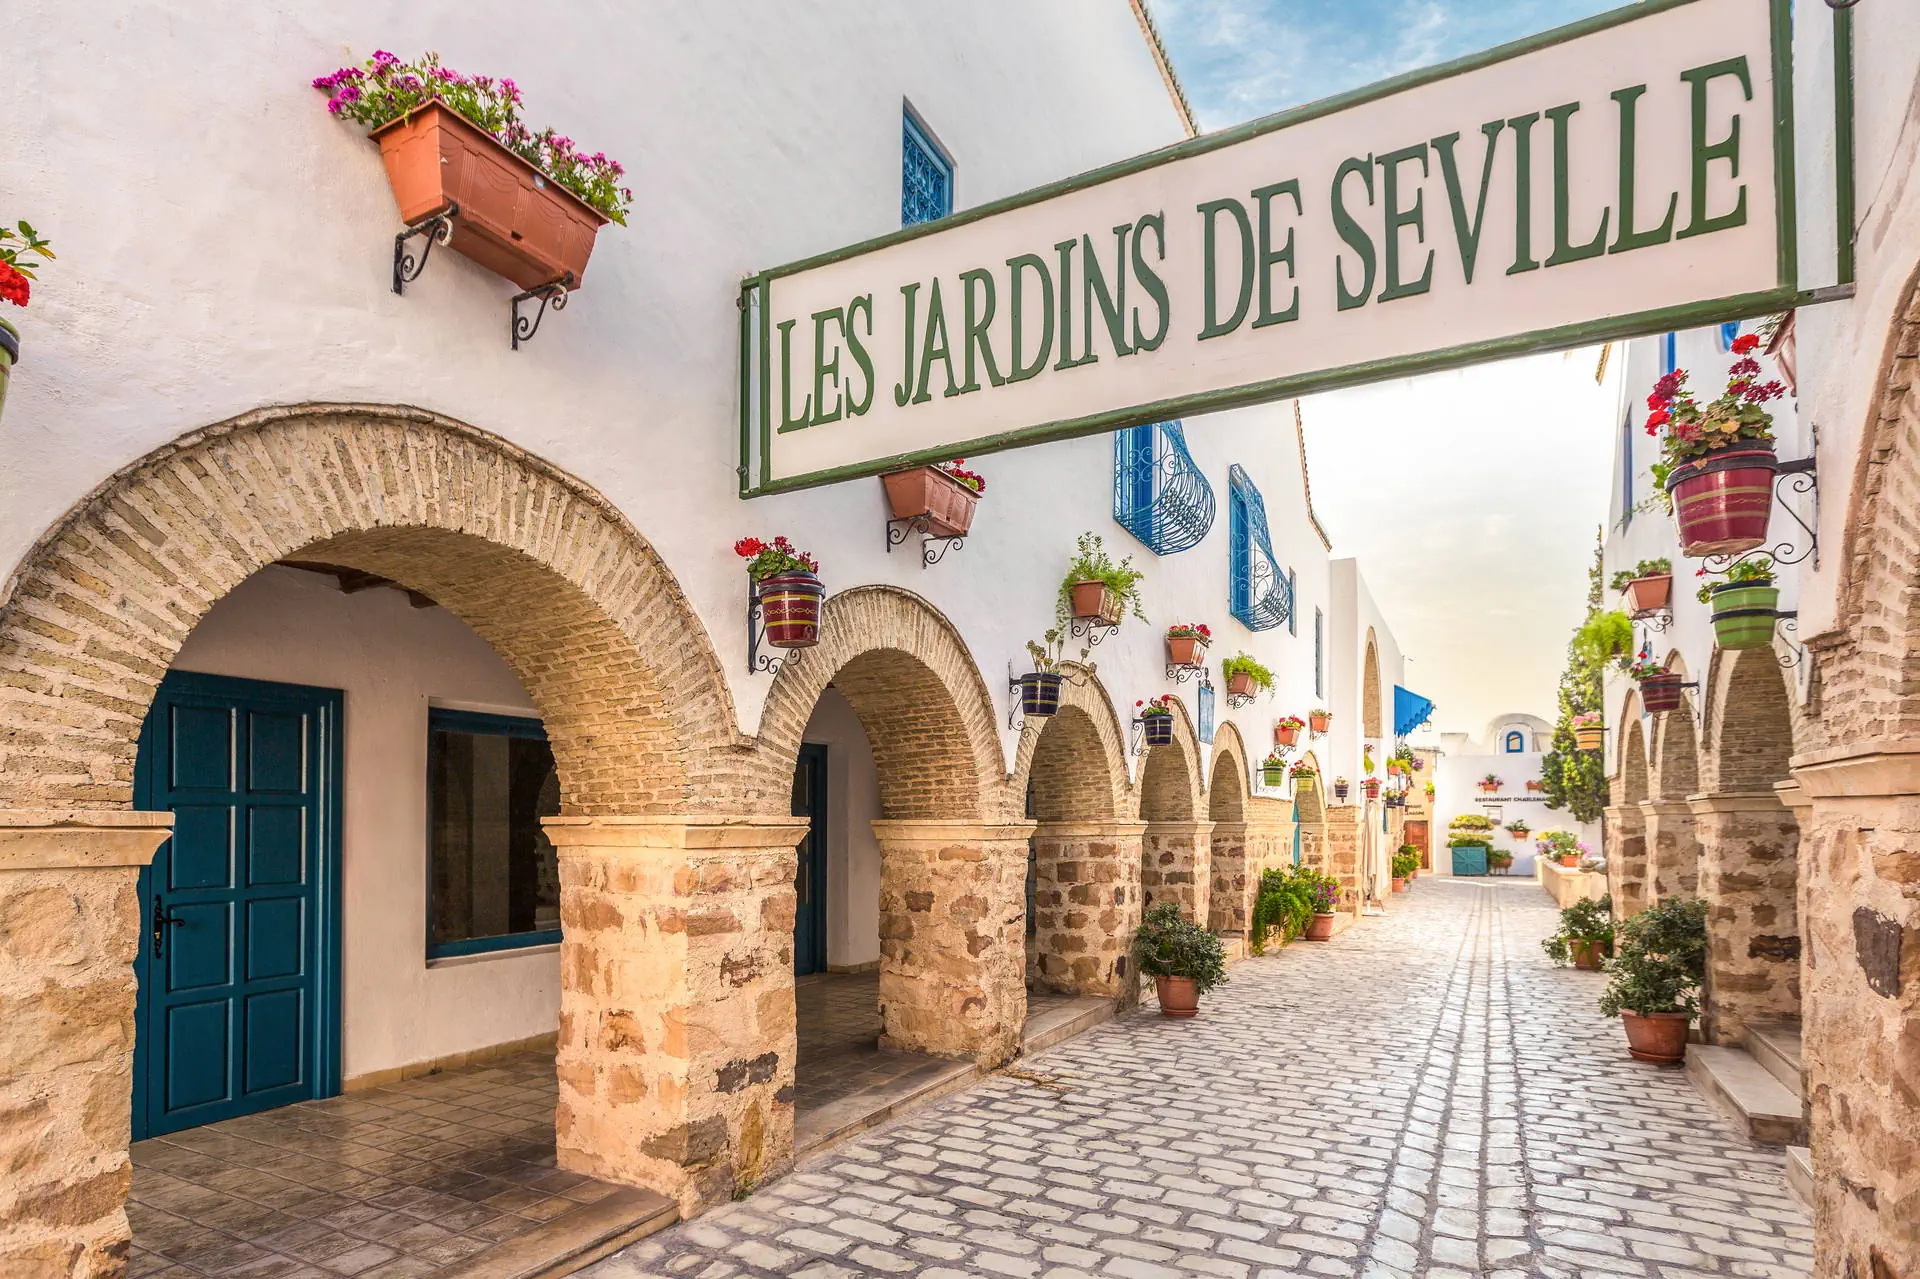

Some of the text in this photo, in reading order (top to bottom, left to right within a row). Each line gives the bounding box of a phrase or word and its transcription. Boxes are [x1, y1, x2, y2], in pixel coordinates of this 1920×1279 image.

[776, 55, 1753, 435] LES JARDINS DE SEVILLE
